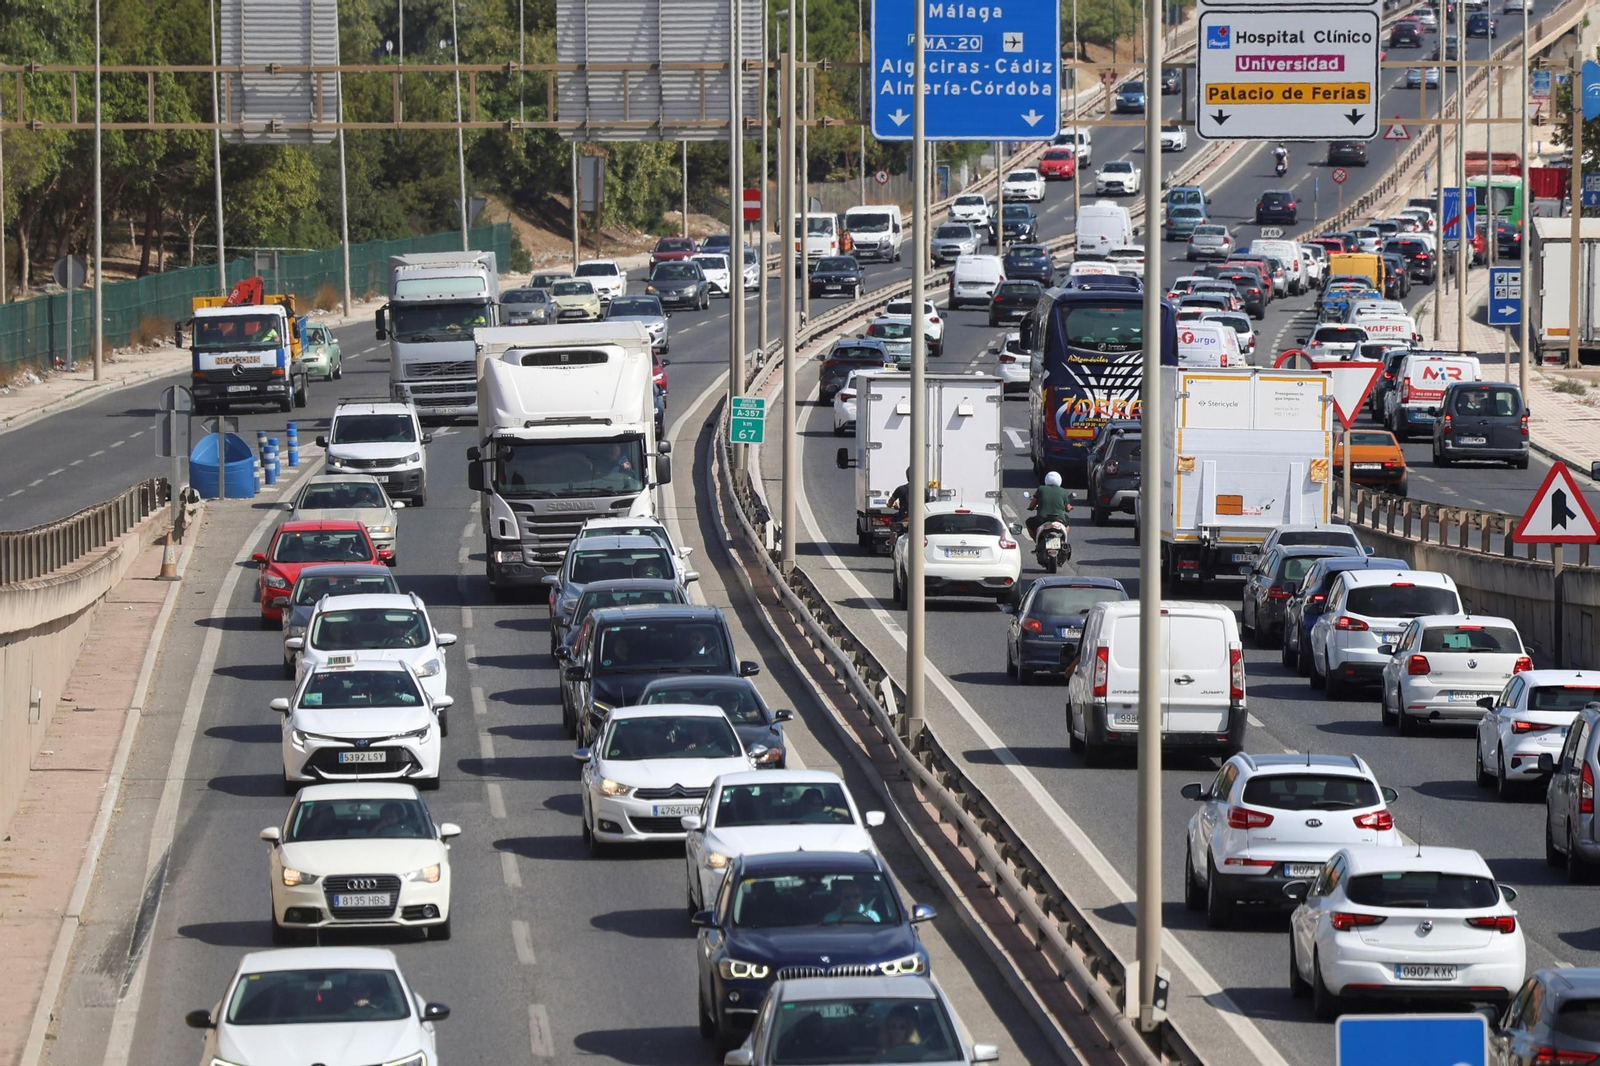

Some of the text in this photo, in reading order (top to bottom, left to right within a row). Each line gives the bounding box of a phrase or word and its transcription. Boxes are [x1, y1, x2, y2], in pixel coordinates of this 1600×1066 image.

[929, 4, 1002, 23] Málaga
[1236, 30, 1305, 46] Hospital
[1314, 30, 1372, 44] Clínico
[881, 59, 980, 78] Algciras
[995, 59, 1052, 74] Cádiz
[1238, 57, 1339, 71] Universidad
[1209, 87, 1367, 100] Palacio de Ferias
[215, 355, 261, 365] NEOCONS
[1207, 400, 1239, 408] Stericycle
[737, 409, 760, 417] A-357
[738, 429, 757, 440] 67
[546, 501, 598, 511] SCANIA
[344, 752, 384, 761] 5392 LSY
[660, 807, 681, 815] 4764
[1293, 866, 1316, 875] 8075
[342, 895, 386, 906] 8135 HBS
[1403, 966, 1454, 977] 0907 KXK
